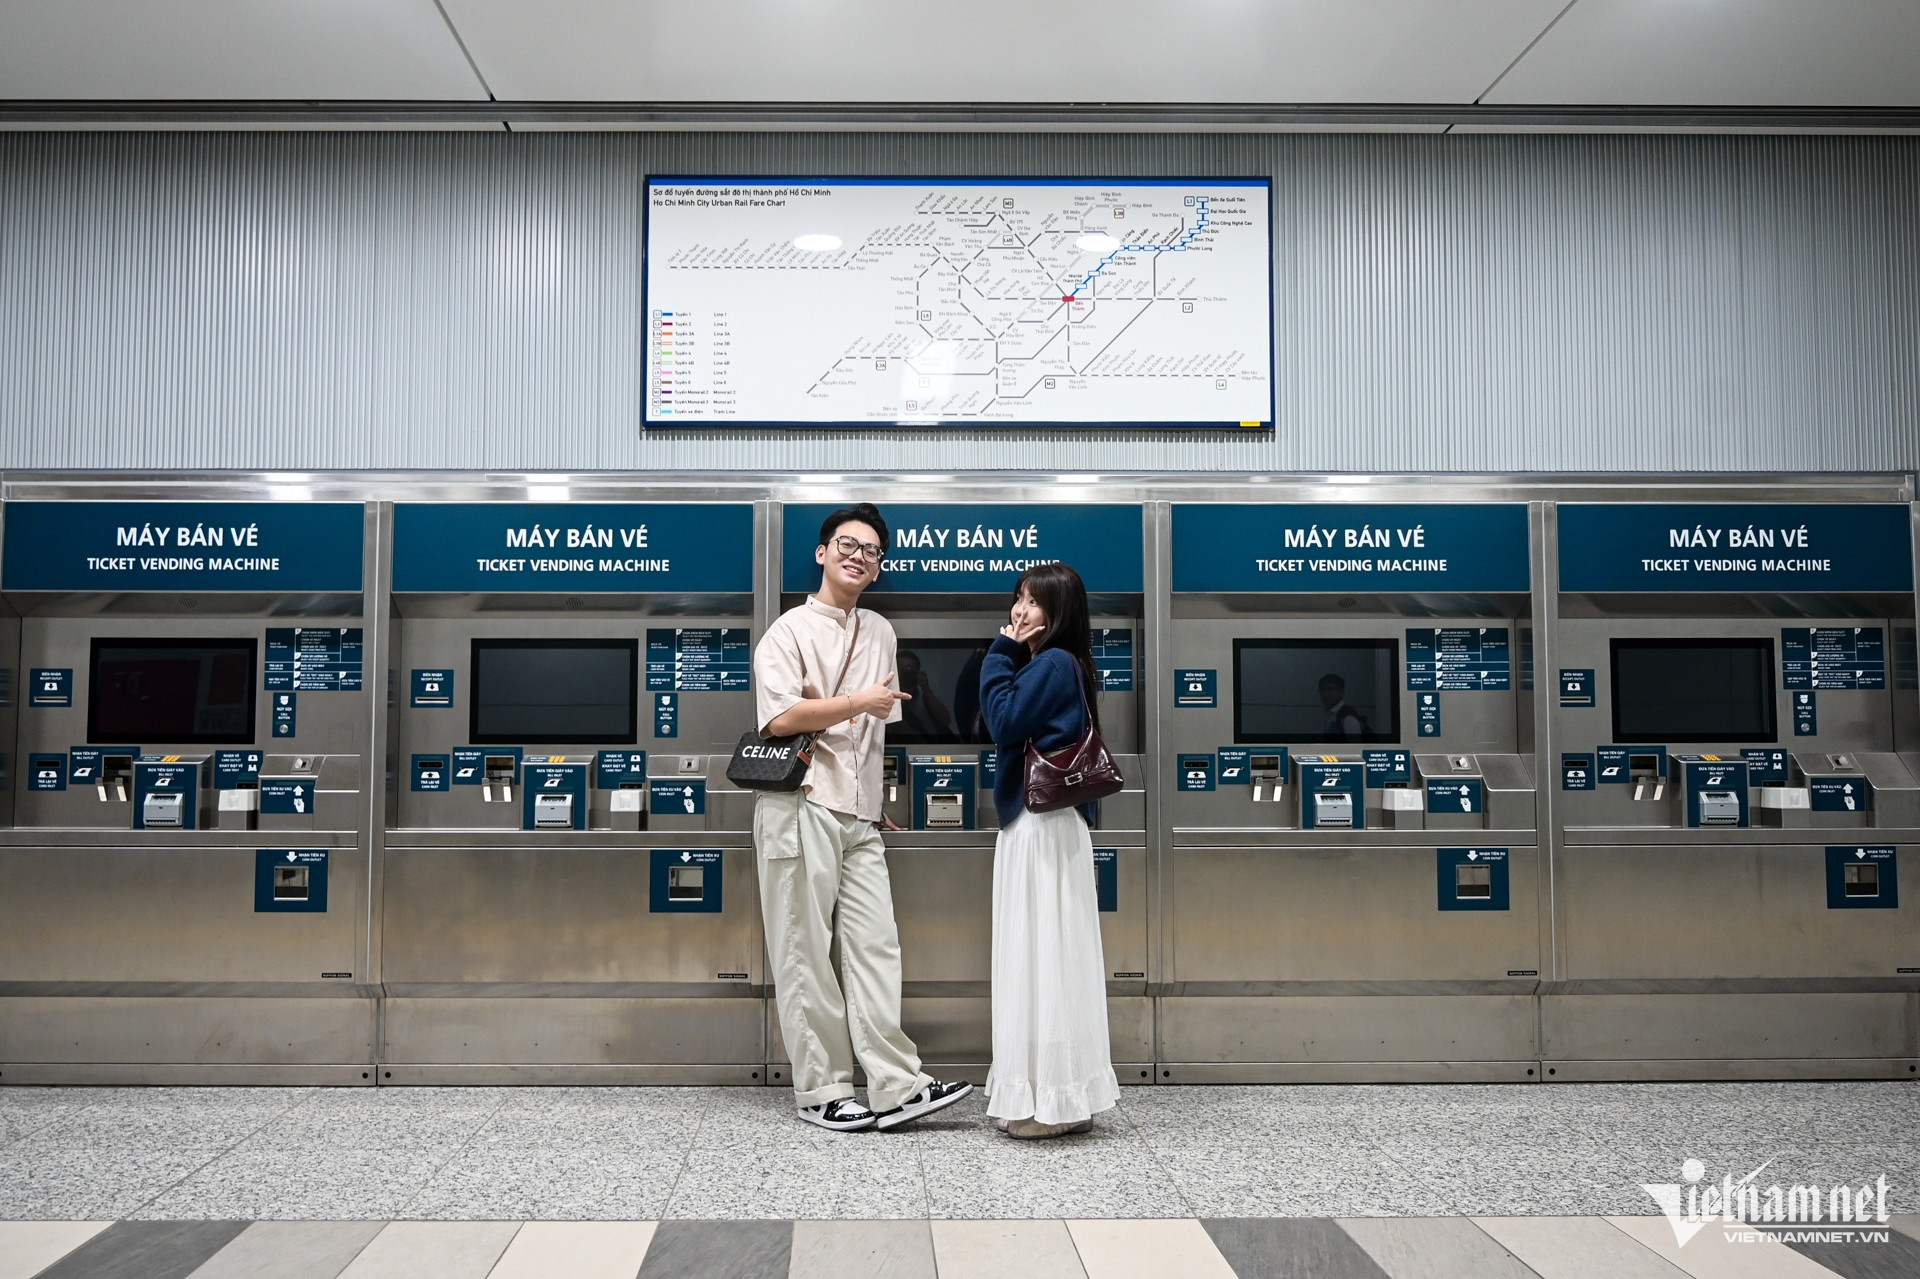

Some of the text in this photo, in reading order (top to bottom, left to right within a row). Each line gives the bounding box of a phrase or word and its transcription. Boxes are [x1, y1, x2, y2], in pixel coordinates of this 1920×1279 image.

[675, 188, 694, 197] tuyến
[696, 189, 718, 197] đường
[720, 188, 730, 196] sắt
[742, 189, 751, 197] thị
[774, 188, 788, 197] phố
[696, 199, 710, 208] City
[117, 523, 258, 546] MÁY BÁN VÉ
[507, 524, 648, 548] MÁY BÁN VÉ
[897, 524, 1038, 548] MÁY BÁN VÉ
[1285, 524, 1425, 548] MÁY BÁN VÉ
[1670, 525, 1808, 547] MÁY BÁN VÉ
[87, 558, 279, 570] TICKET VENDING MACHINE
[477, 559, 669, 571] TICKET VENDING MACHINE
[880, 559, 916, 572] CKET
[920, 559, 984, 572] VENDING
[1256, 559, 1447, 571] TICKET VENDING MACHINE
[1641, 559, 1831, 571] TICKET VENDING MACHINE
[742, 745, 791, 760] CELINE
